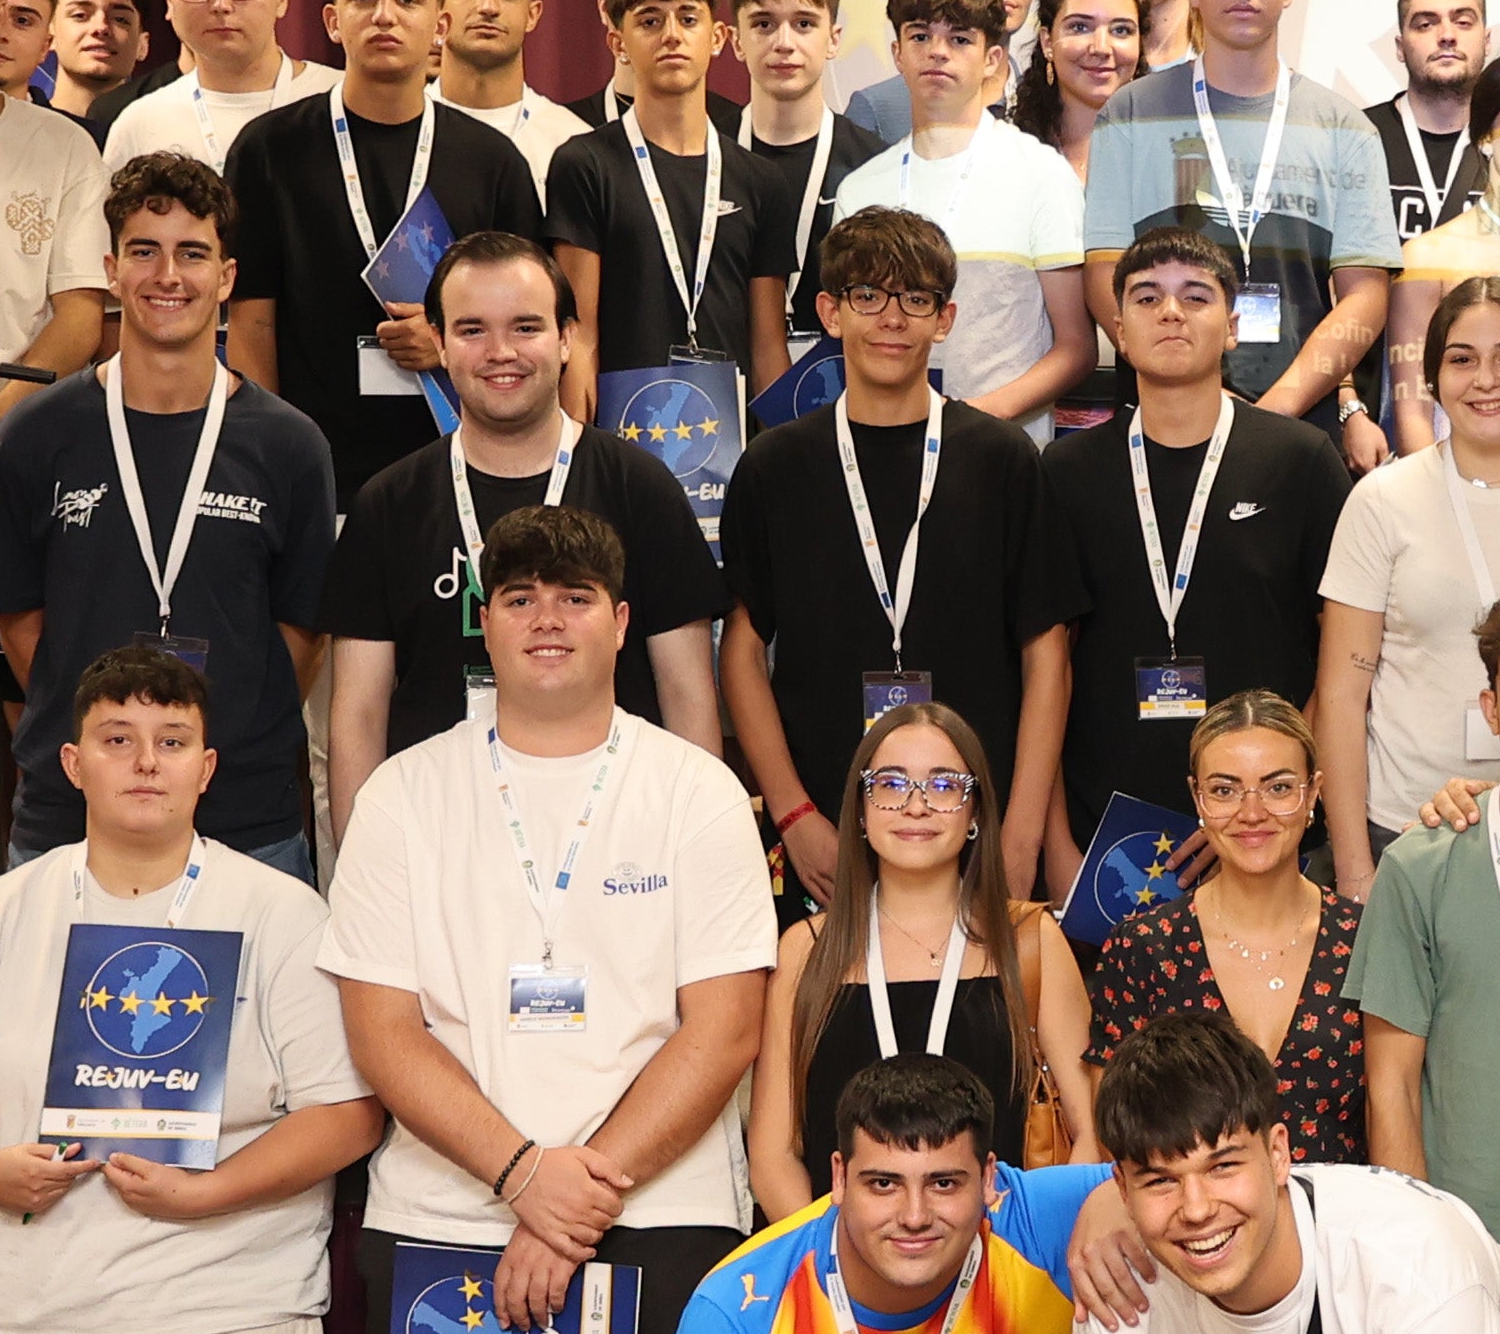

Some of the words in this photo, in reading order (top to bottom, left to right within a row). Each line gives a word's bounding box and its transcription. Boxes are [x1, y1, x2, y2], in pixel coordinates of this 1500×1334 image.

[201, 491, 250, 511] HAKE
[1234, 501, 1259, 515] NIKE
[603, 873, 669, 896] Sevilla
[74, 1064, 201, 1092] REJUV-EU
